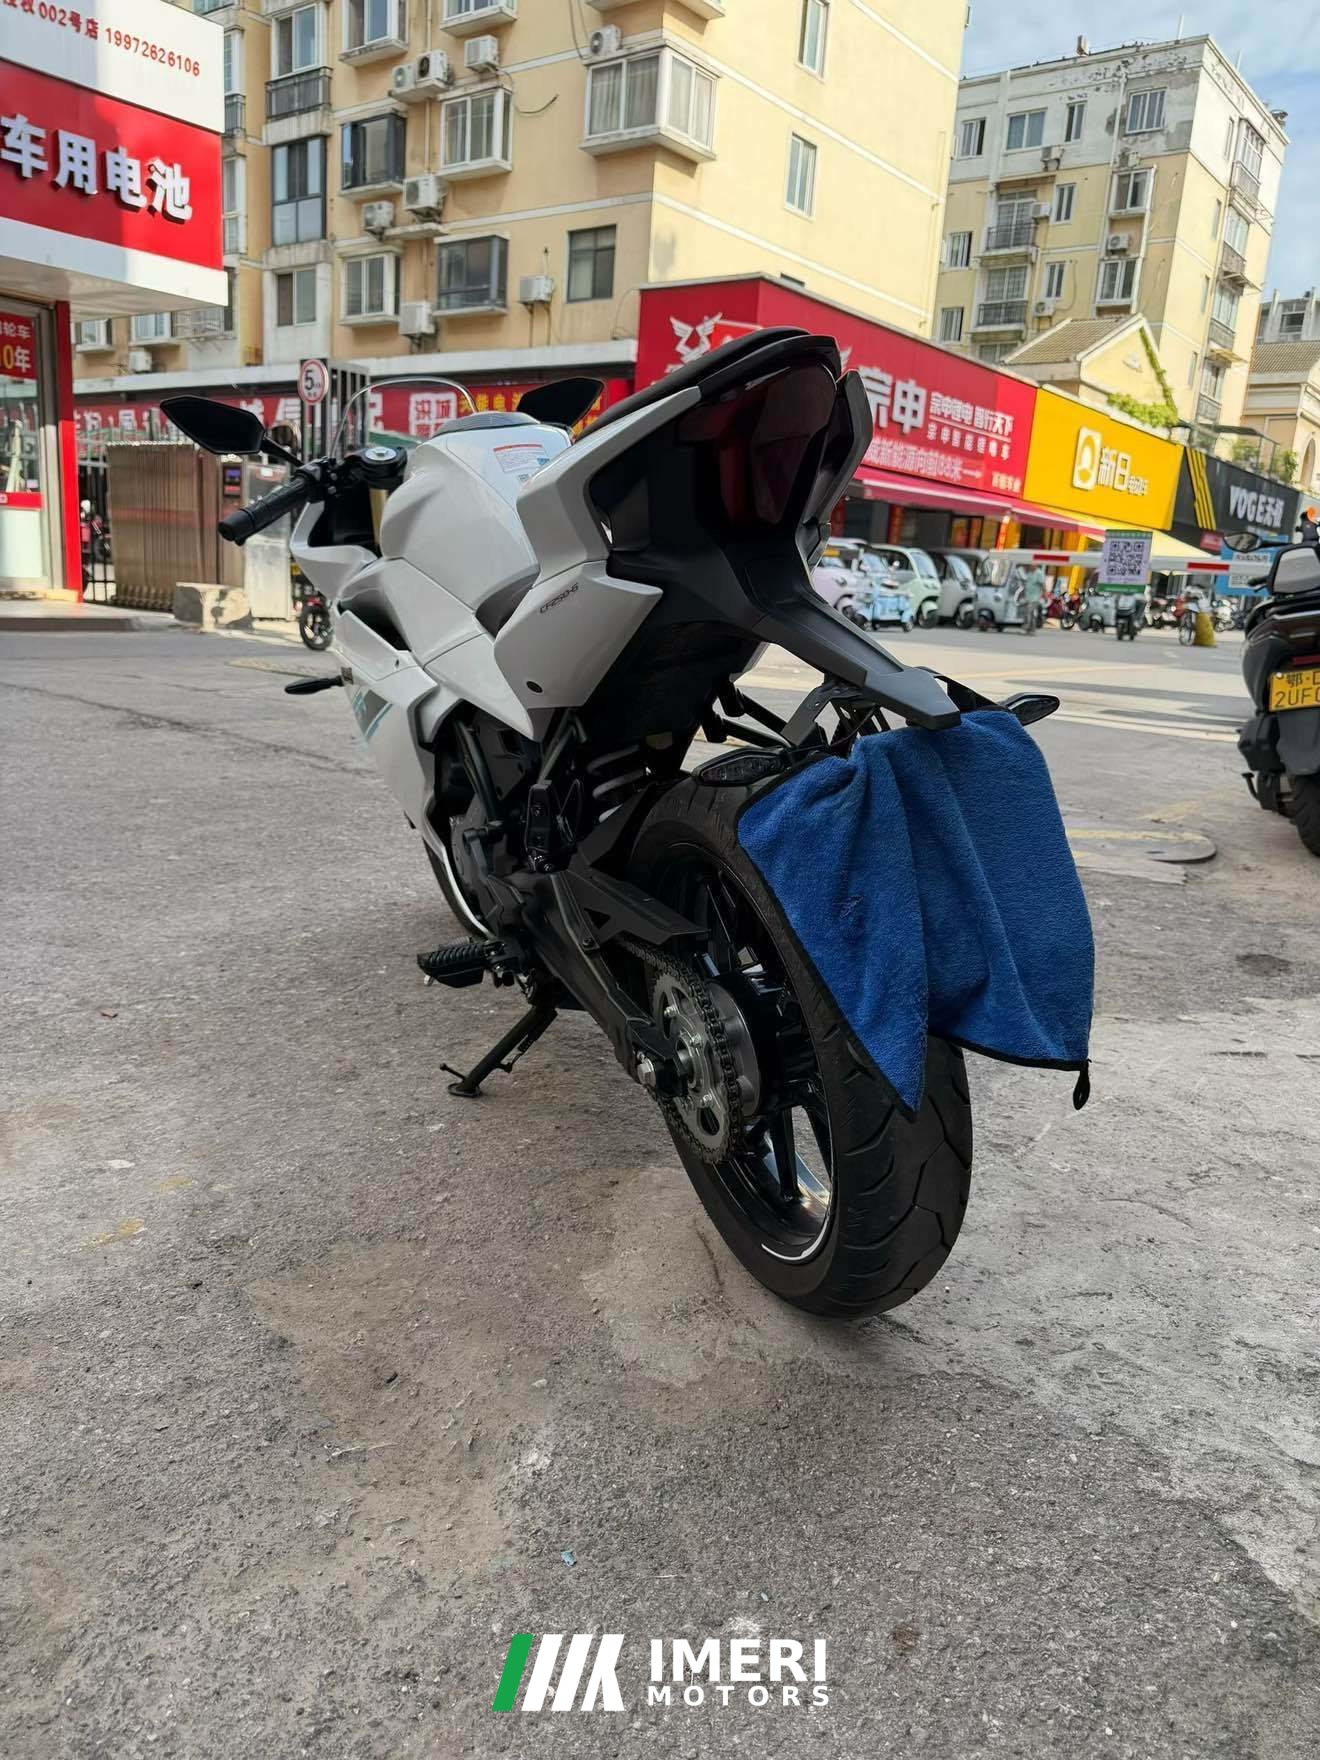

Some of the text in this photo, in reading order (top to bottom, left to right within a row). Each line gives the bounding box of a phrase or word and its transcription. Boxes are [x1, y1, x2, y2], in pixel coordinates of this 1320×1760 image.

[105, 27, 201, 77] 19972626106
[0, 114, 193, 221] 车用电池
[304, 369, 314, 391] 5
[858, 364, 927, 435] 宗申
[1097, 447, 1131, 491] 新日
